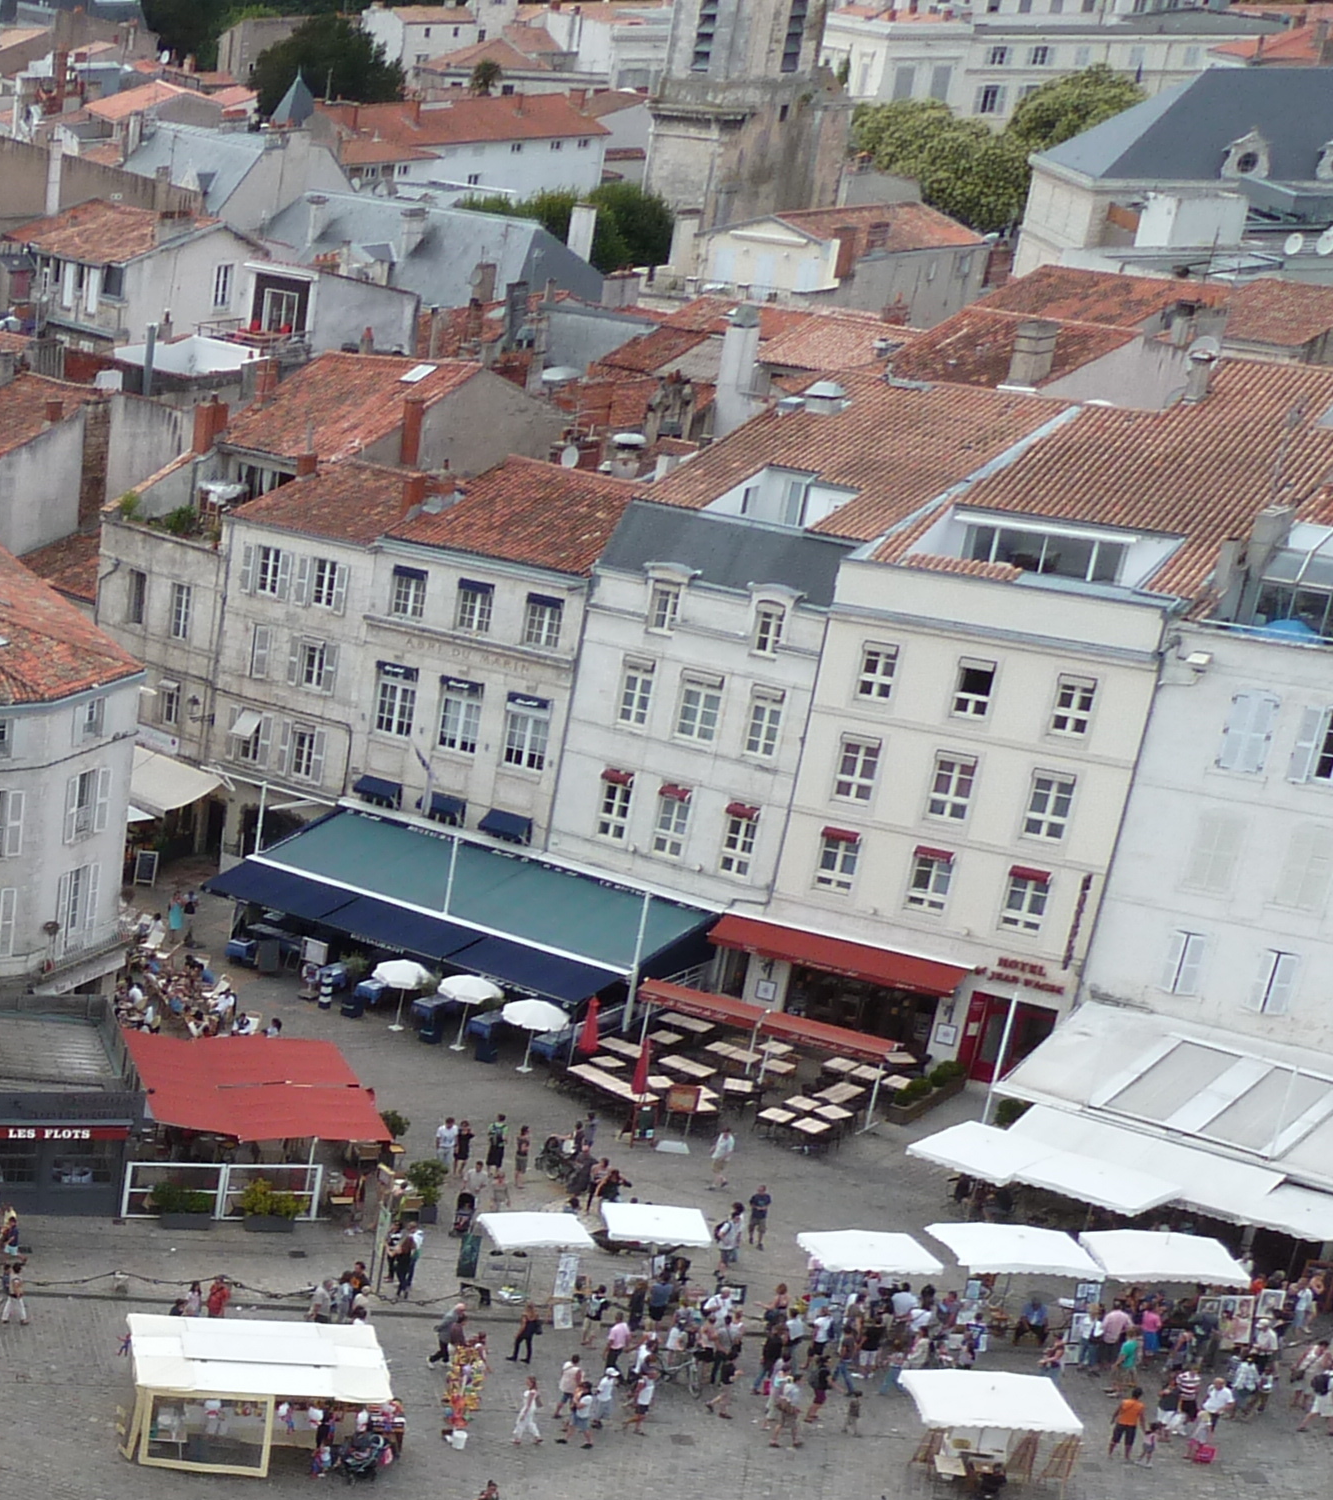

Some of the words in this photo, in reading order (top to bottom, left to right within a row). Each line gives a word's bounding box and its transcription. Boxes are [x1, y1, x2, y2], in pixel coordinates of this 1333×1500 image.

[451, 648, 471, 660] DU
[8, 1129, 36, 1139] LES
[44, 1129, 91, 1140] FLOTS
